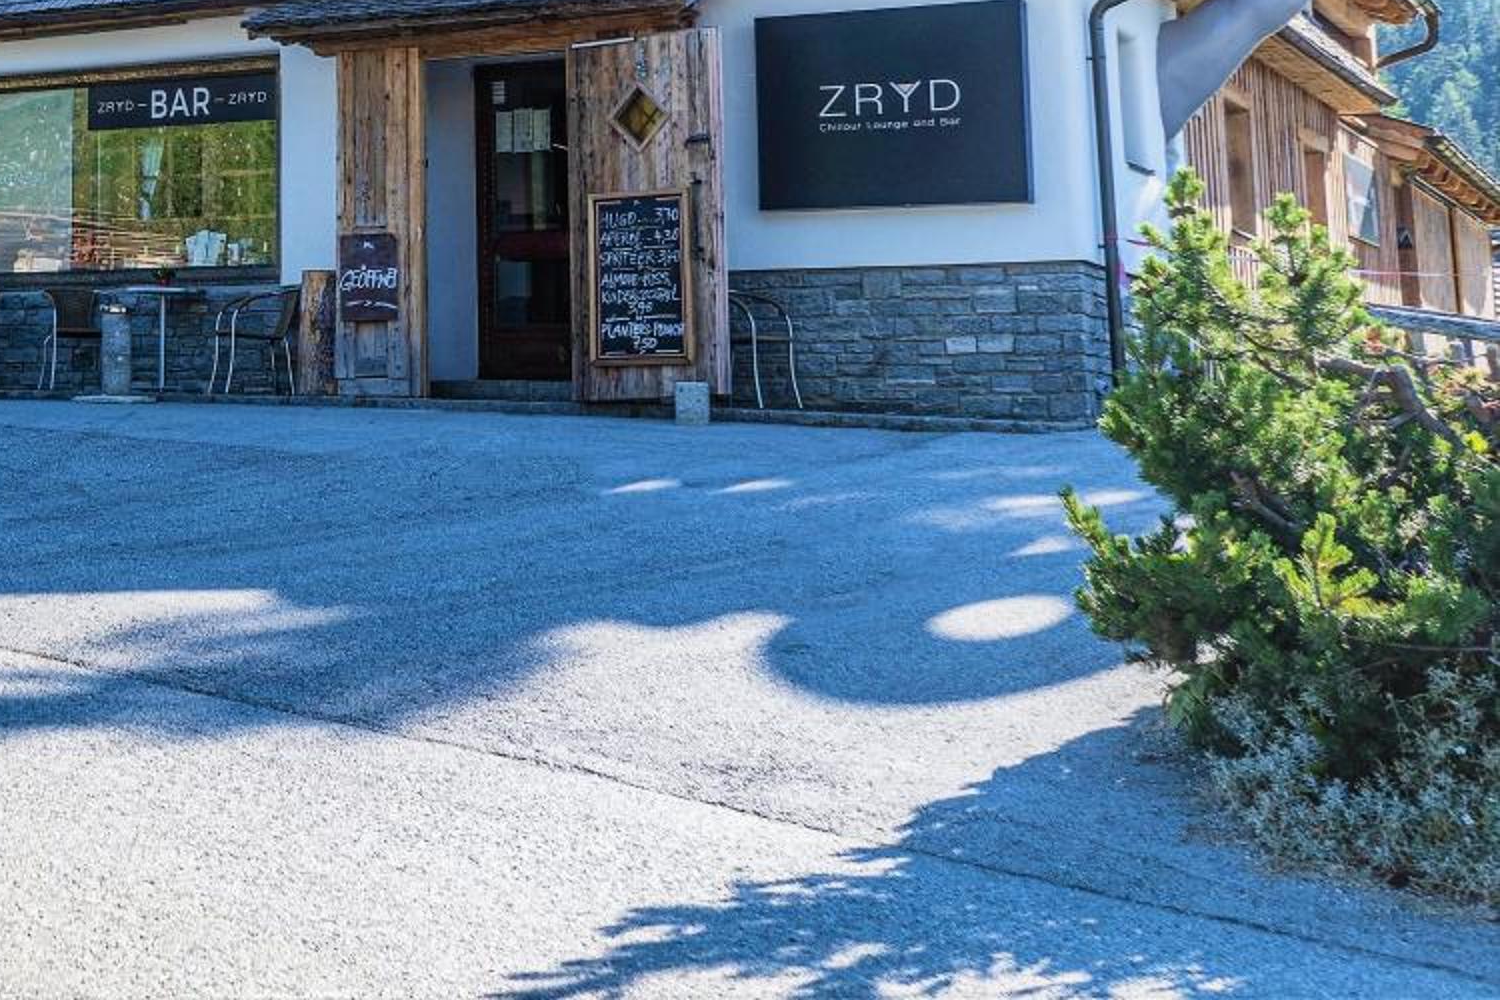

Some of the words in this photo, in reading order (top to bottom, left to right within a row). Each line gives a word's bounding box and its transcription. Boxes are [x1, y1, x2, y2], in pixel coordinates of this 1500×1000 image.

[150, 87, 211, 119] BAR
[819, 79, 961, 117] ZRYD
[913, 118, 936, 127] and
[940, 117, 961, 127] Bar
